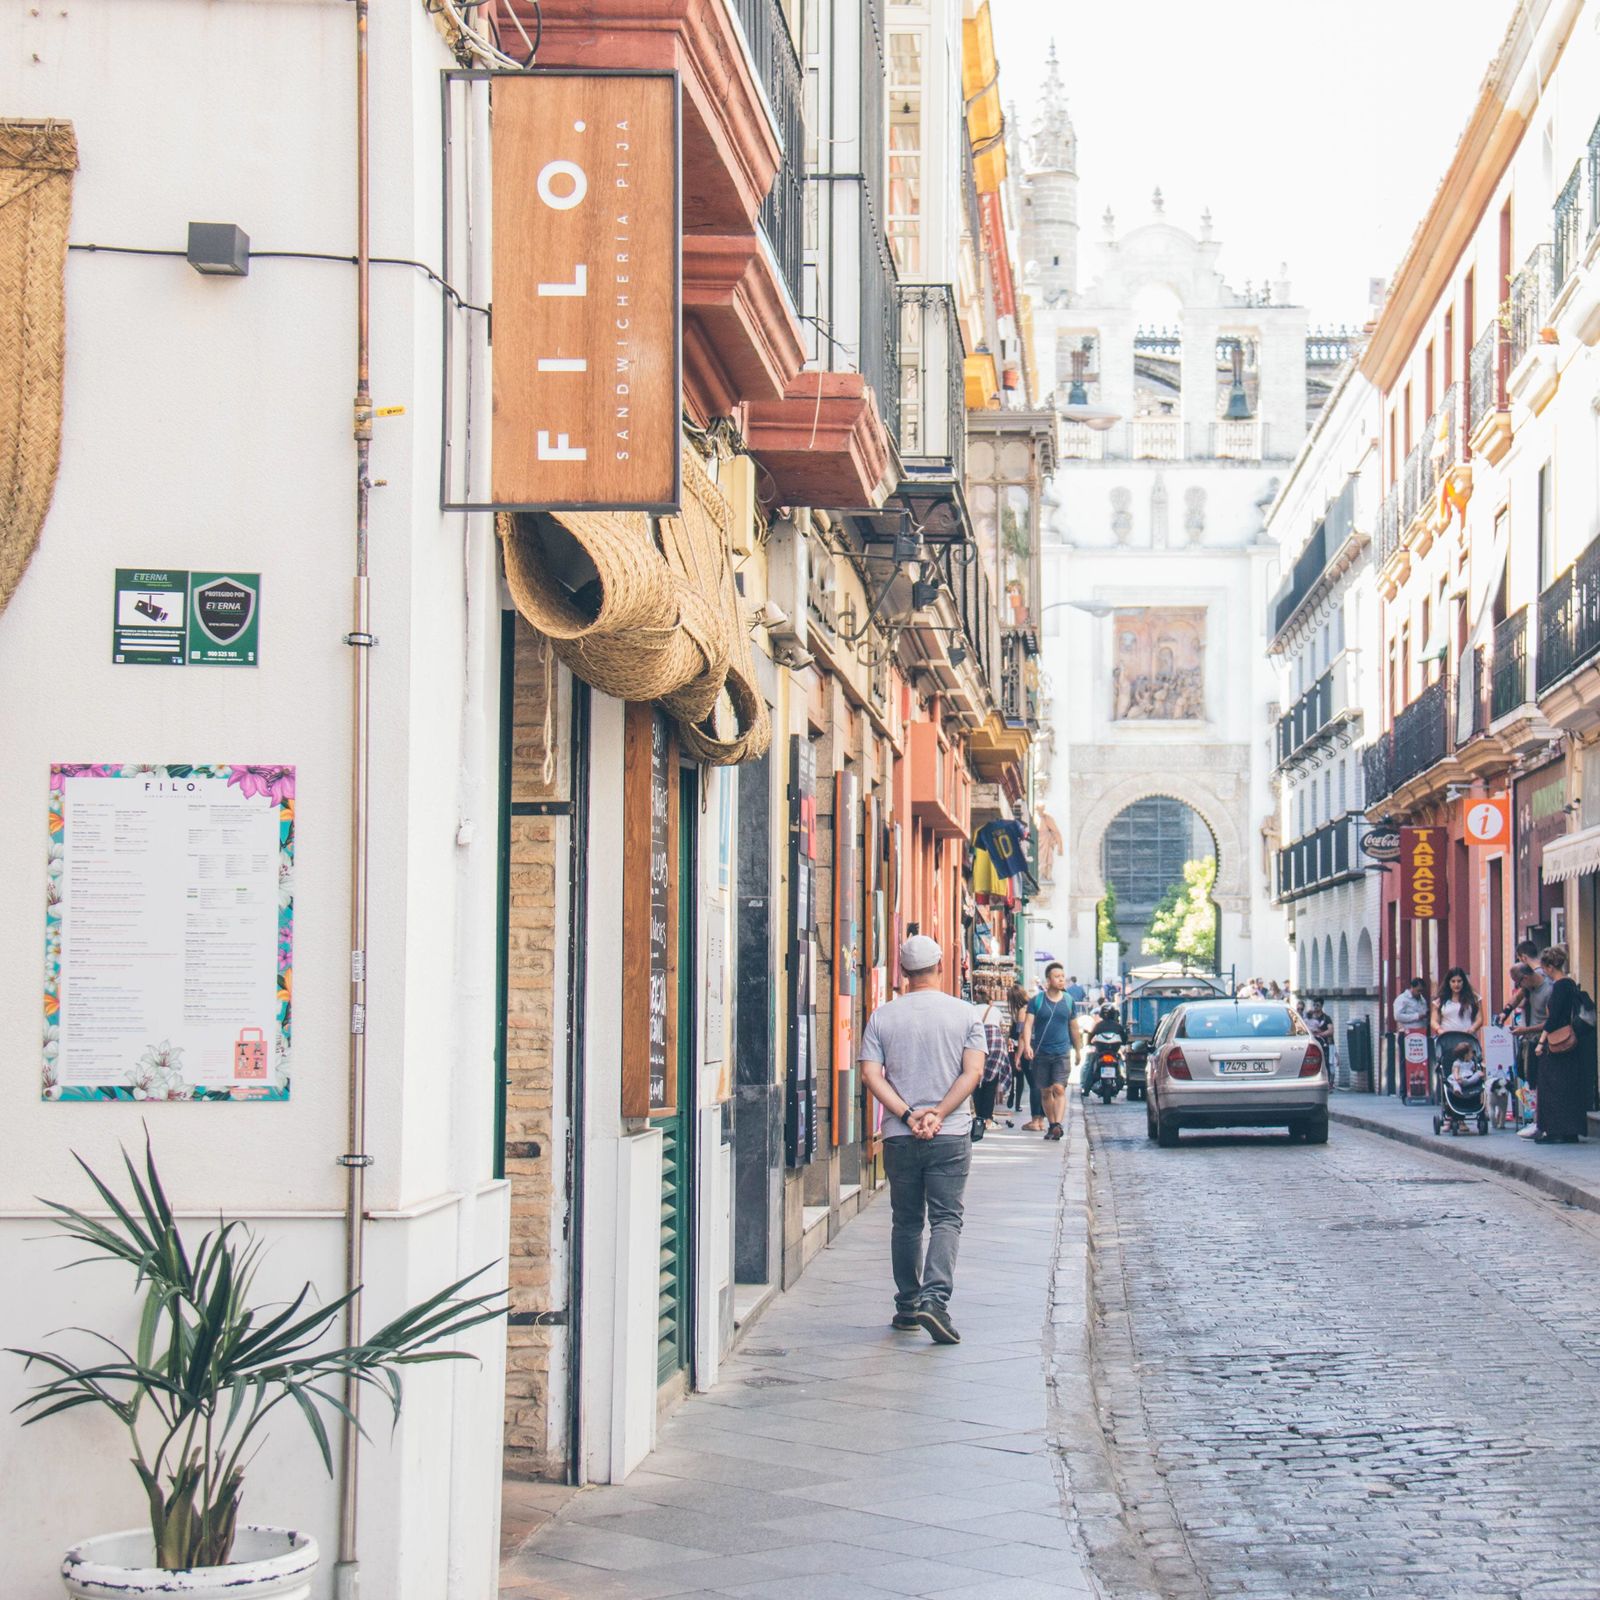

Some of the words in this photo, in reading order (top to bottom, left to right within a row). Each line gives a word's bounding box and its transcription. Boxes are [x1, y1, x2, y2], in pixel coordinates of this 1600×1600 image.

[615, 120, 630, 188] PIJA
[537, 120, 588, 461] FILO.
[993, 834, 1014, 860] 10
[1412, 829, 1436, 917] TABACOS
[1225, 1062, 1247, 1071] 7479
[1253, 1062, 1268, 1071] CKL
